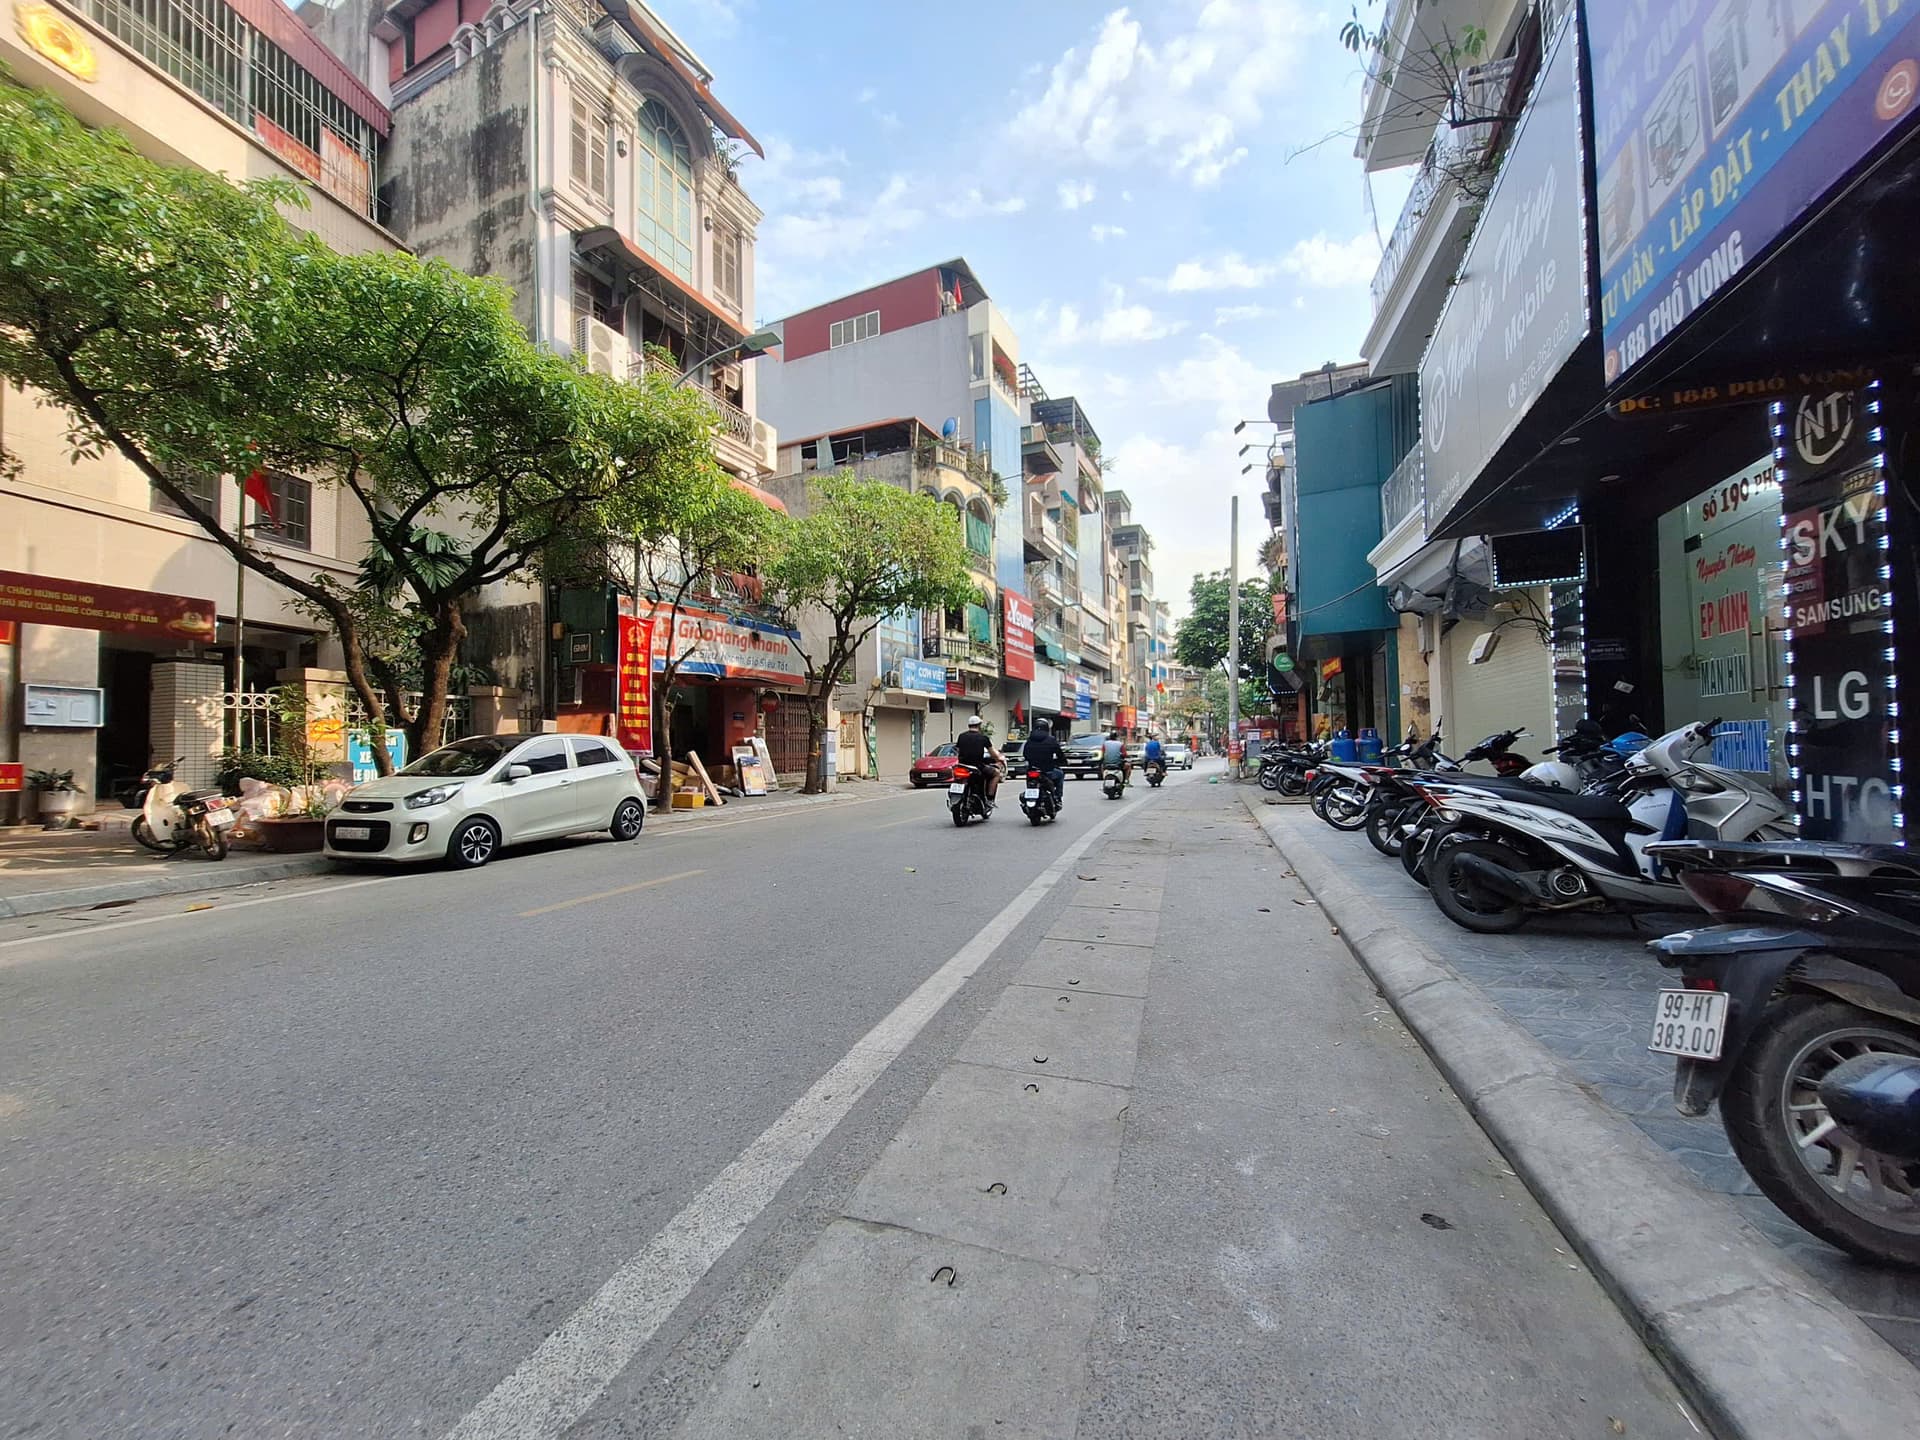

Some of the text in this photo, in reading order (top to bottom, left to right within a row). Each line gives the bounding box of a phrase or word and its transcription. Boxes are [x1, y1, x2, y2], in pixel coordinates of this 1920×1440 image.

[1775, 12, 1851, 132] THAY
[1504, 259, 1556, 360] Mobile
[1618, 321, 1646, 374] 188
[1650, 271, 1684, 346] PHỐ
[1673, 386, 1717, 405] 188
[1720, 477, 1750, 513] 190
[1792, 490, 1873, 566] SKY
[1795, 588, 1881, 628] SAMSUNG
[1813, 670, 1871, 720] LG
[1805, 773, 1892, 827] HTC
[1663, 994, 1713, 1023] 99-H1
[1654, 1022, 1716, 1054] 383.00
